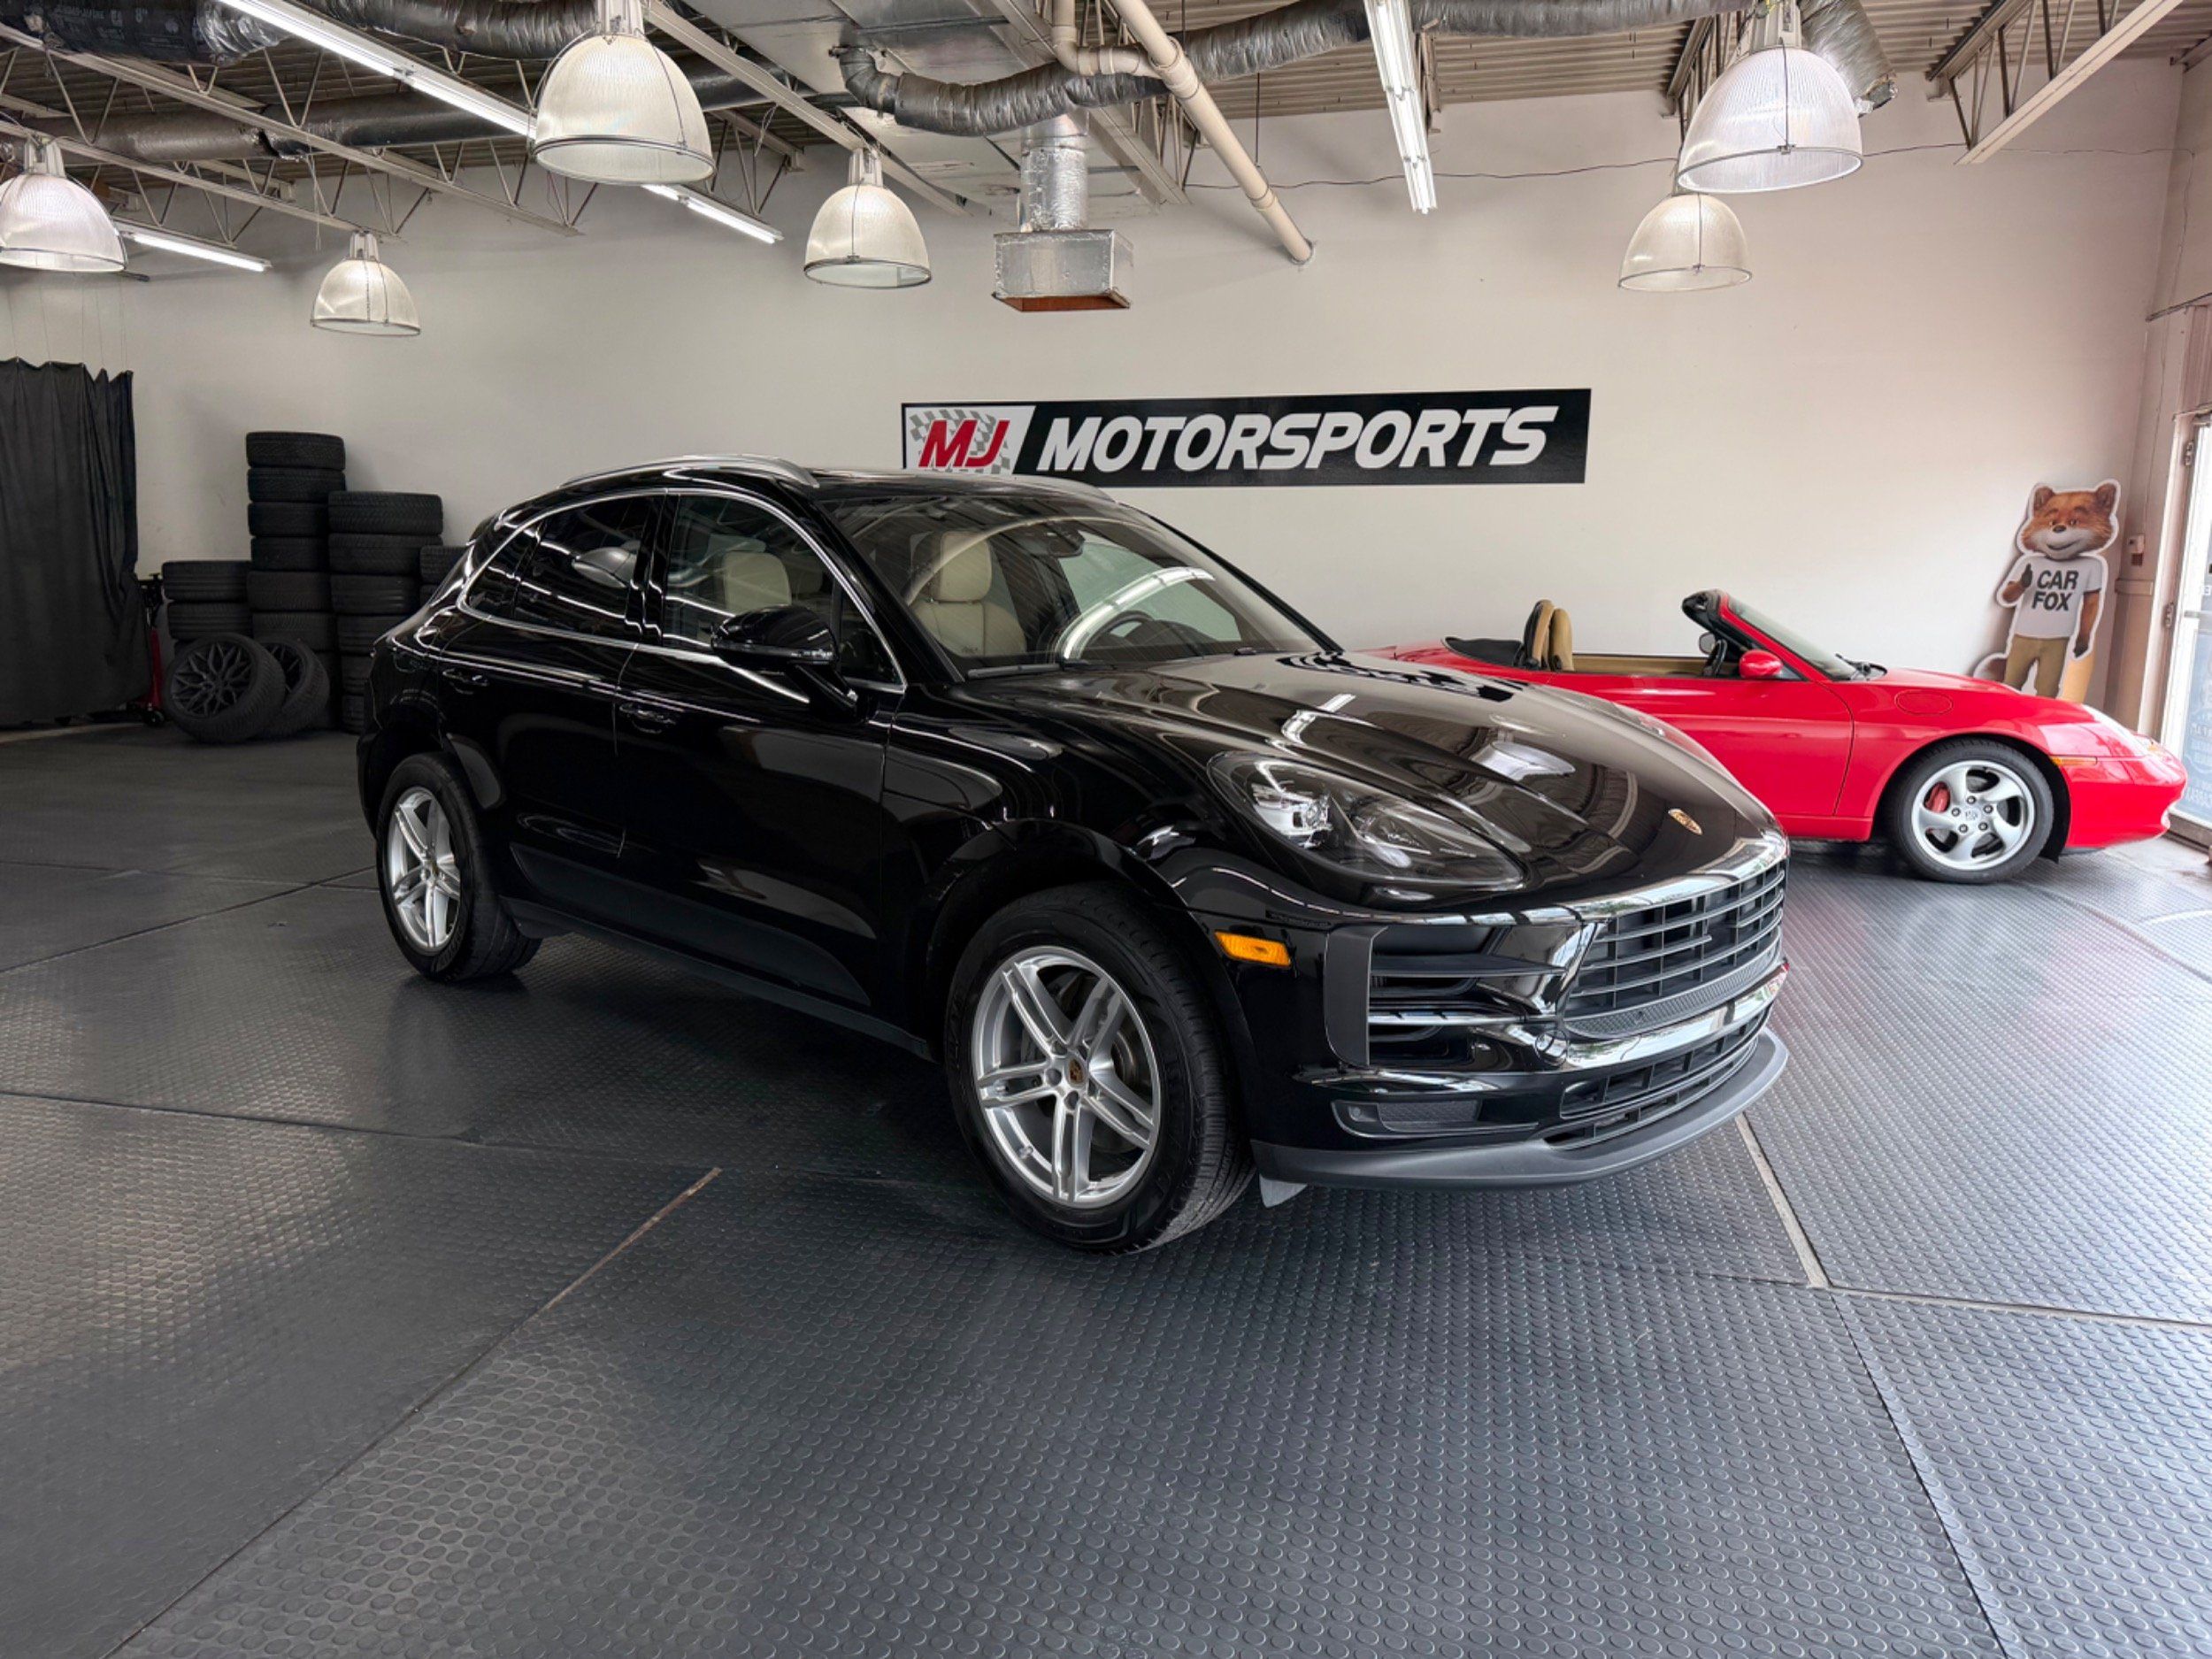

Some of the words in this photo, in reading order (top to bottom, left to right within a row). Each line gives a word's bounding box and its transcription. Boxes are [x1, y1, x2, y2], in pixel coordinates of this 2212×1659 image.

[918, 419, 1010, 467] MJ
[1036, 406, 1560, 473] MOTORSPORTS
[2038, 571, 2078, 589] CAR
[2032, 592, 2071, 611] FOX
